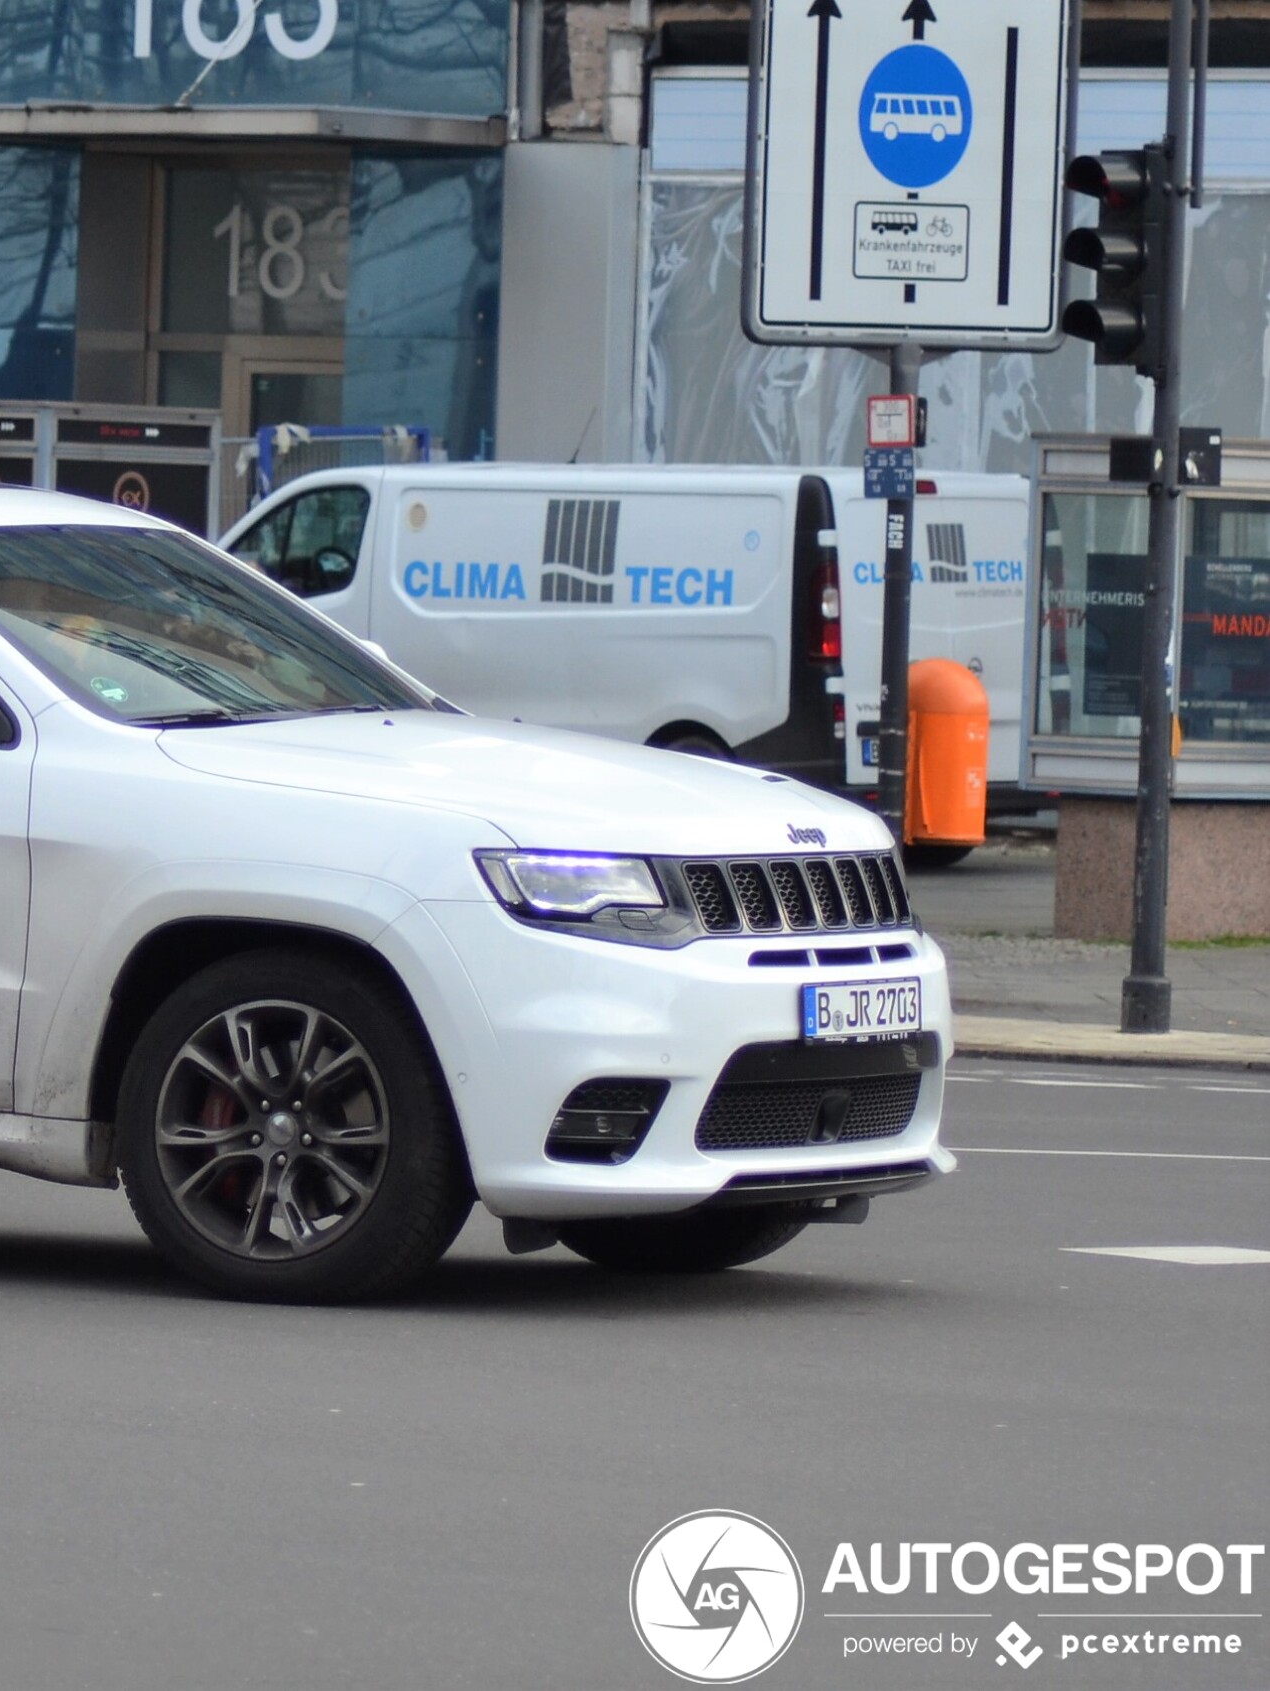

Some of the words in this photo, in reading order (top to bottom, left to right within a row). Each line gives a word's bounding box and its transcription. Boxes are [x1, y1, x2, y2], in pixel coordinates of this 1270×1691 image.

[859, 239, 963, 256] Krankenfahrzeuge
[886, 260, 912, 272] TAXI
[916, 260, 936, 273] frei
[403, 561, 526, 599] CLIMA
[625, 566, 733, 605] TECH
[853, 560, 924, 583] CLA
[972, 560, 1023, 582] TECH
[787, 823, 827, 848] Jeep
[818, 992, 831, 1029] B
[846, 990, 871, 1027] JR
[876, 986, 917, 1025] 2703
